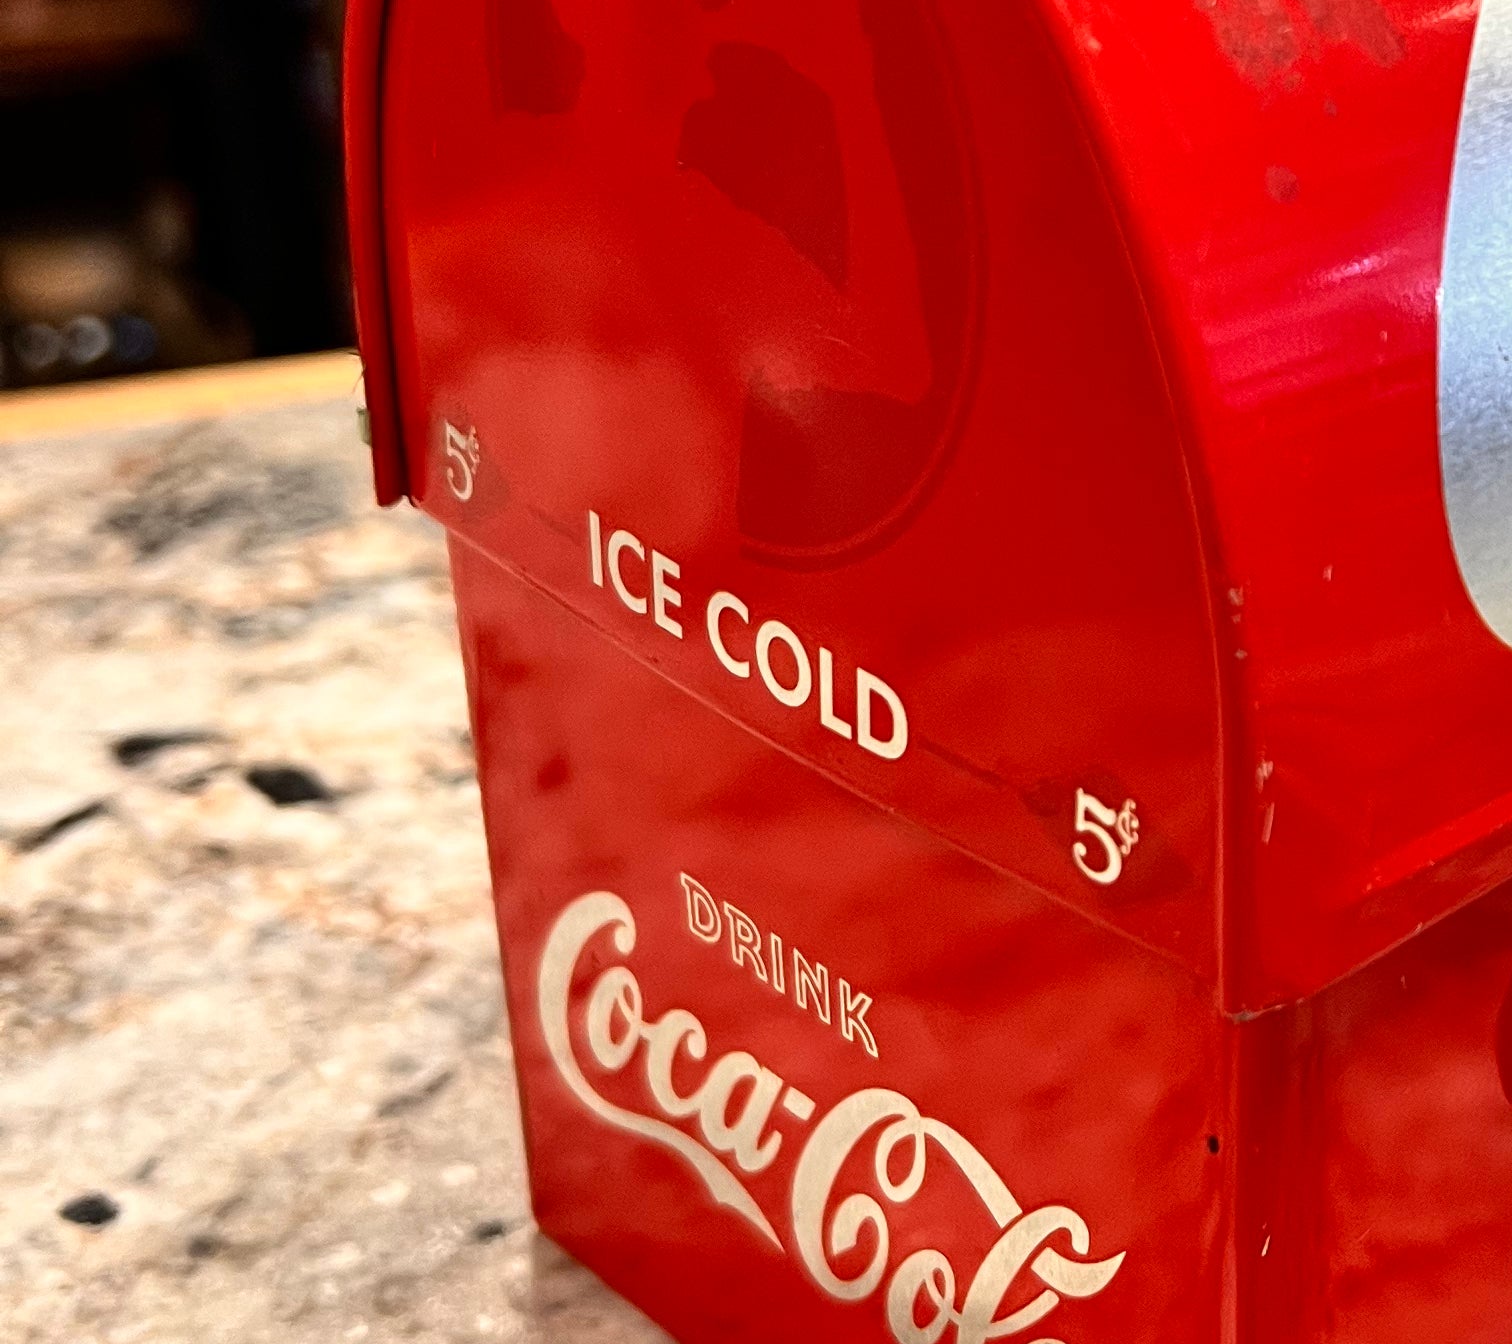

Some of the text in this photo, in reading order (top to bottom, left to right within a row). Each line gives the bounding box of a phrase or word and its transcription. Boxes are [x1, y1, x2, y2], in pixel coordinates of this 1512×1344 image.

[443, 418, 1140, 885] 5¢ ICE COLD 5¢
[679, 870, 879, 1059] DRINK
